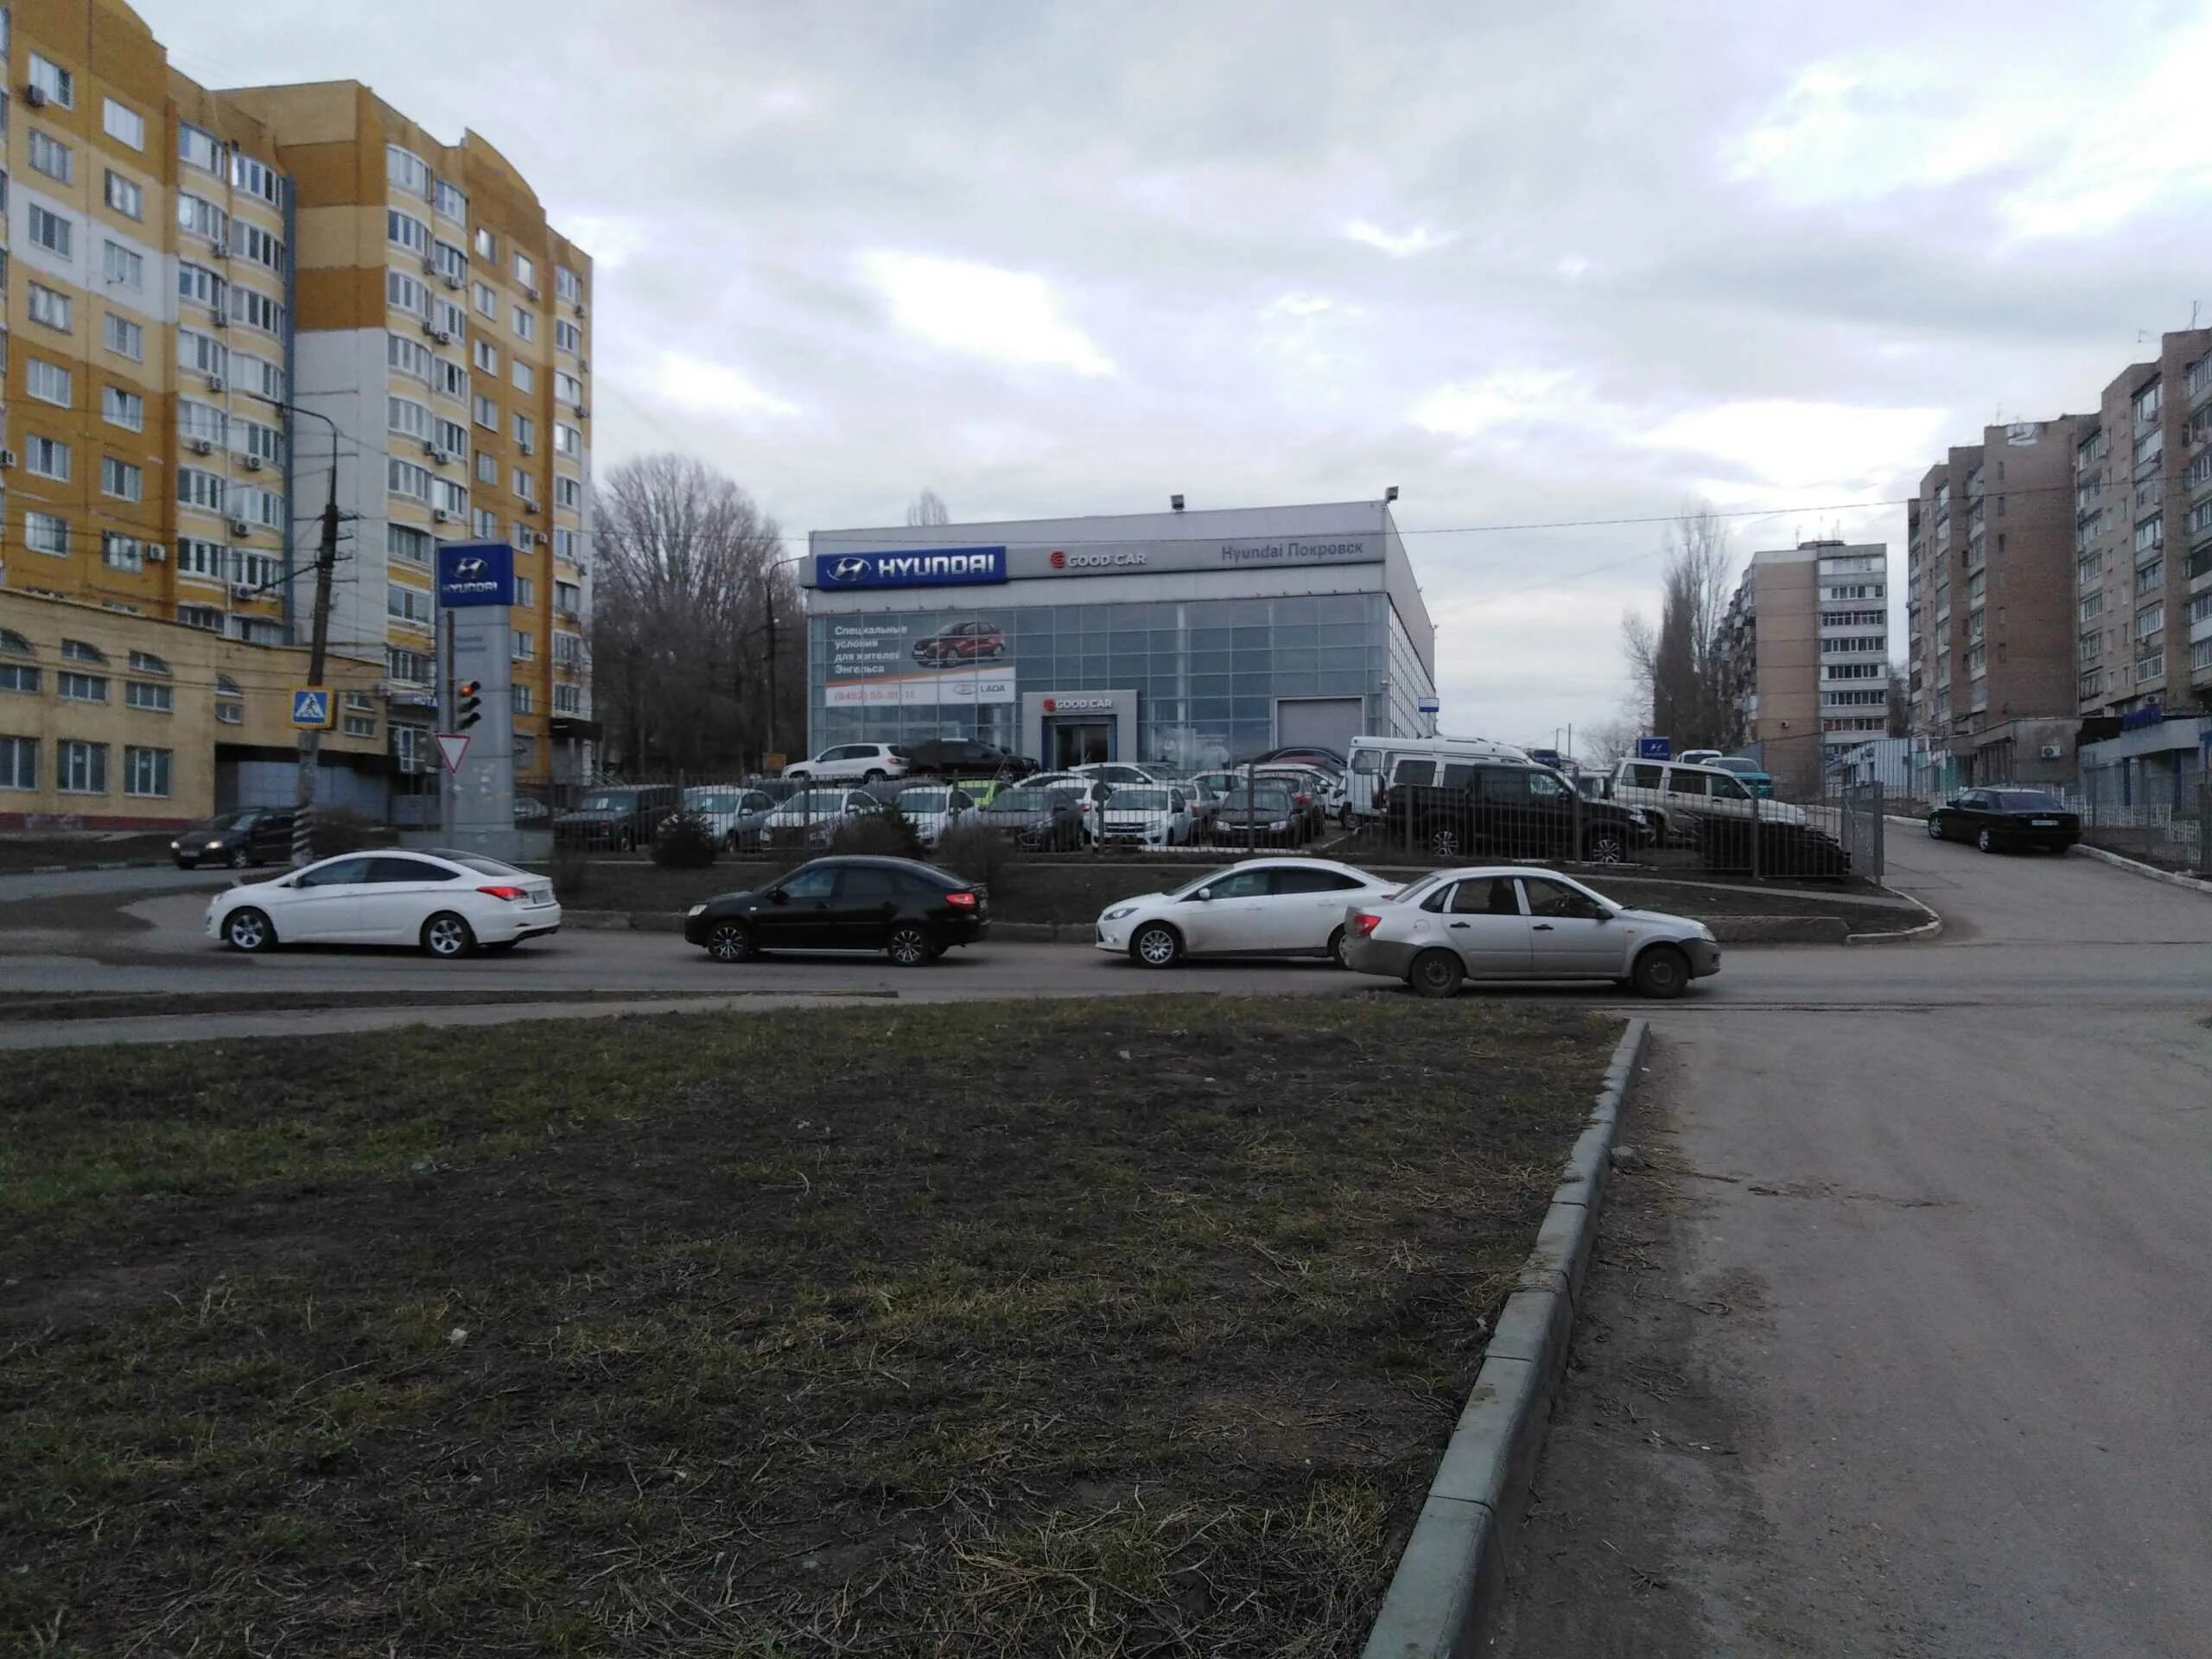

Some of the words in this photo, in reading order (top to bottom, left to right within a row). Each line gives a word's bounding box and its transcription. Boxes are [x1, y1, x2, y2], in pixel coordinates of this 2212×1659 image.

[1222, 544, 1283, 562] Hyundai
[1288, 543, 1363, 557] Покровск
[879, 555, 995, 576] HYUNDAI
[1068, 555, 1110, 567] GOOD
[1115, 553, 1147, 565] CAR
[442, 582, 498, 593] HYUNDAI
[834, 625, 907, 637] Специальные
[834, 639, 879, 650] условия
[834, 652, 854, 662] для
[856, 650, 900, 660] жителей
[834, 664, 886, 675] Энгельса
[981, 684, 1005, 693] LADA
[1056, 699, 1087, 709] GOOD
[1090, 698, 1113, 708] CAR
